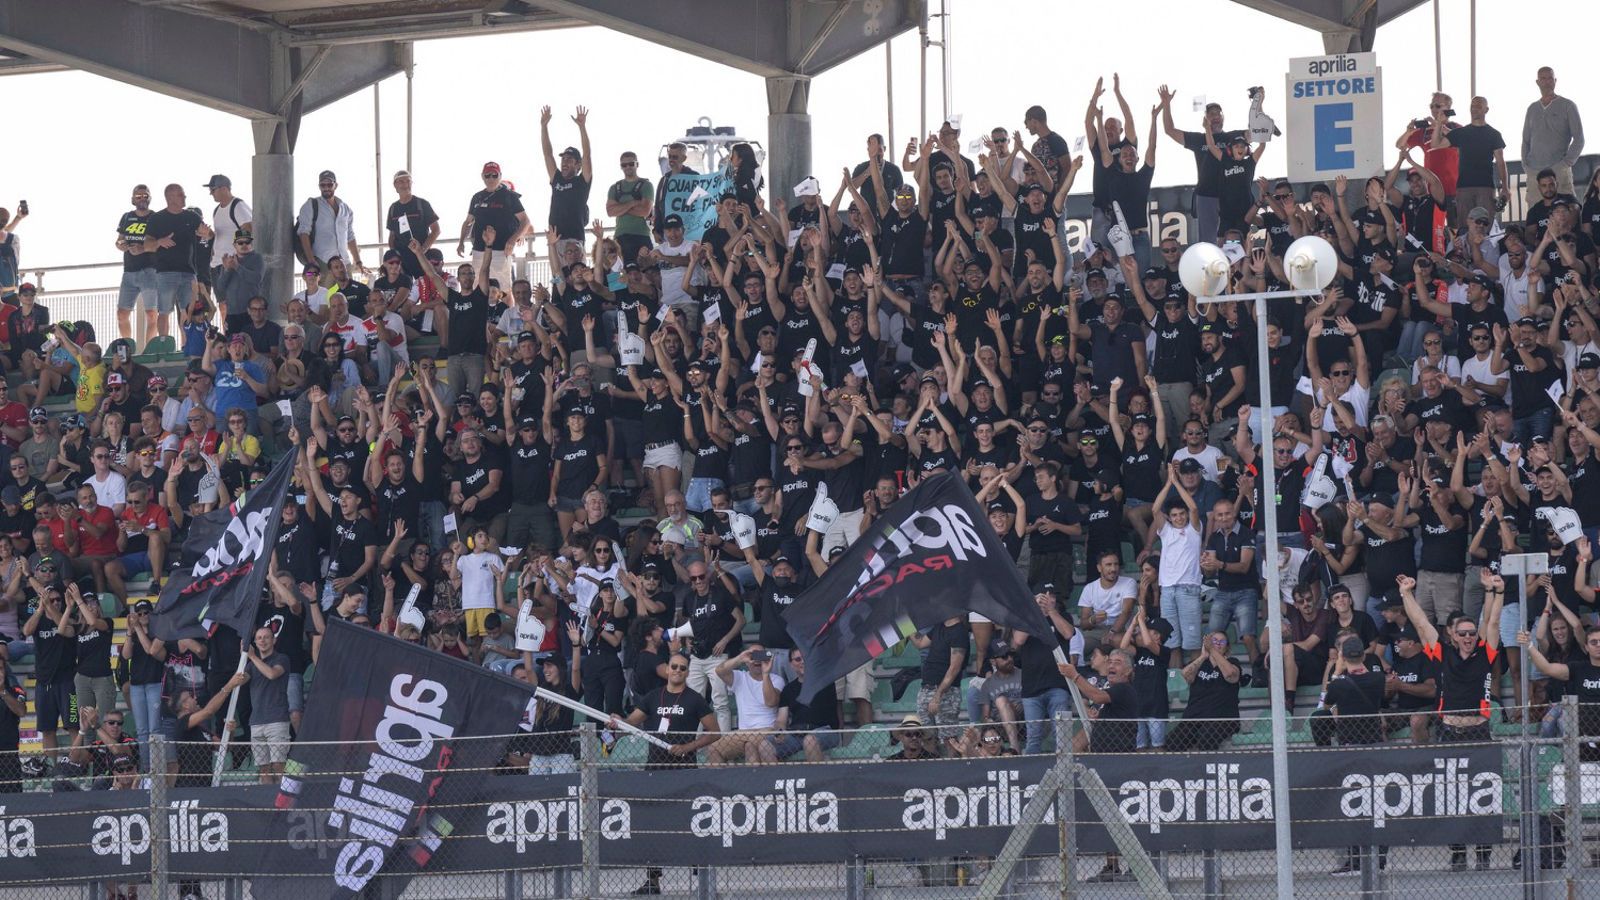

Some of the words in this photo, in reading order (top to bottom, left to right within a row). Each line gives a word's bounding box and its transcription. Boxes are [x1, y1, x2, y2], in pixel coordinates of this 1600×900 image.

[1308, 55, 1356, 76] aprilia
[1294, 78, 1375, 98] SETTORE
[1314, 102, 1354, 171] E
[126, 223, 146, 234] 46
[1271, 224, 1289, 233] april
[923, 322, 945, 332] april
[735, 434, 749, 446] prilia
[564, 450, 587, 461] aprilia
[466, 469, 485, 484] aprilia
[783, 481, 808, 492] aprilia
[328, 493, 342, 503] apri
[1311, 491, 1327, 499] aprilia
[813, 513, 830, 523] aprilia
[1558, 521, 1575, 533] aprilia
[1368, 538, 1385, 546] apri
[1549, 565, 1566, 575] rilia
[695, 604, 716, 617] pria
[39, 627, 58, 638] apri
[520, 632, 538, 640] aprilia
[1399, 673, 1417, 682] prilia
[1583, 679, 1600, 689] apri
[657, 705, 684, 716] aprilia
[1119, 763, 1274, 834] aprilia
[1340, 758, 1503, 828] aprilia
[690, 778, 838, 848] aprilia
[486, 786, 632, 854] apria
[91, 799, 229, 866] apilia
